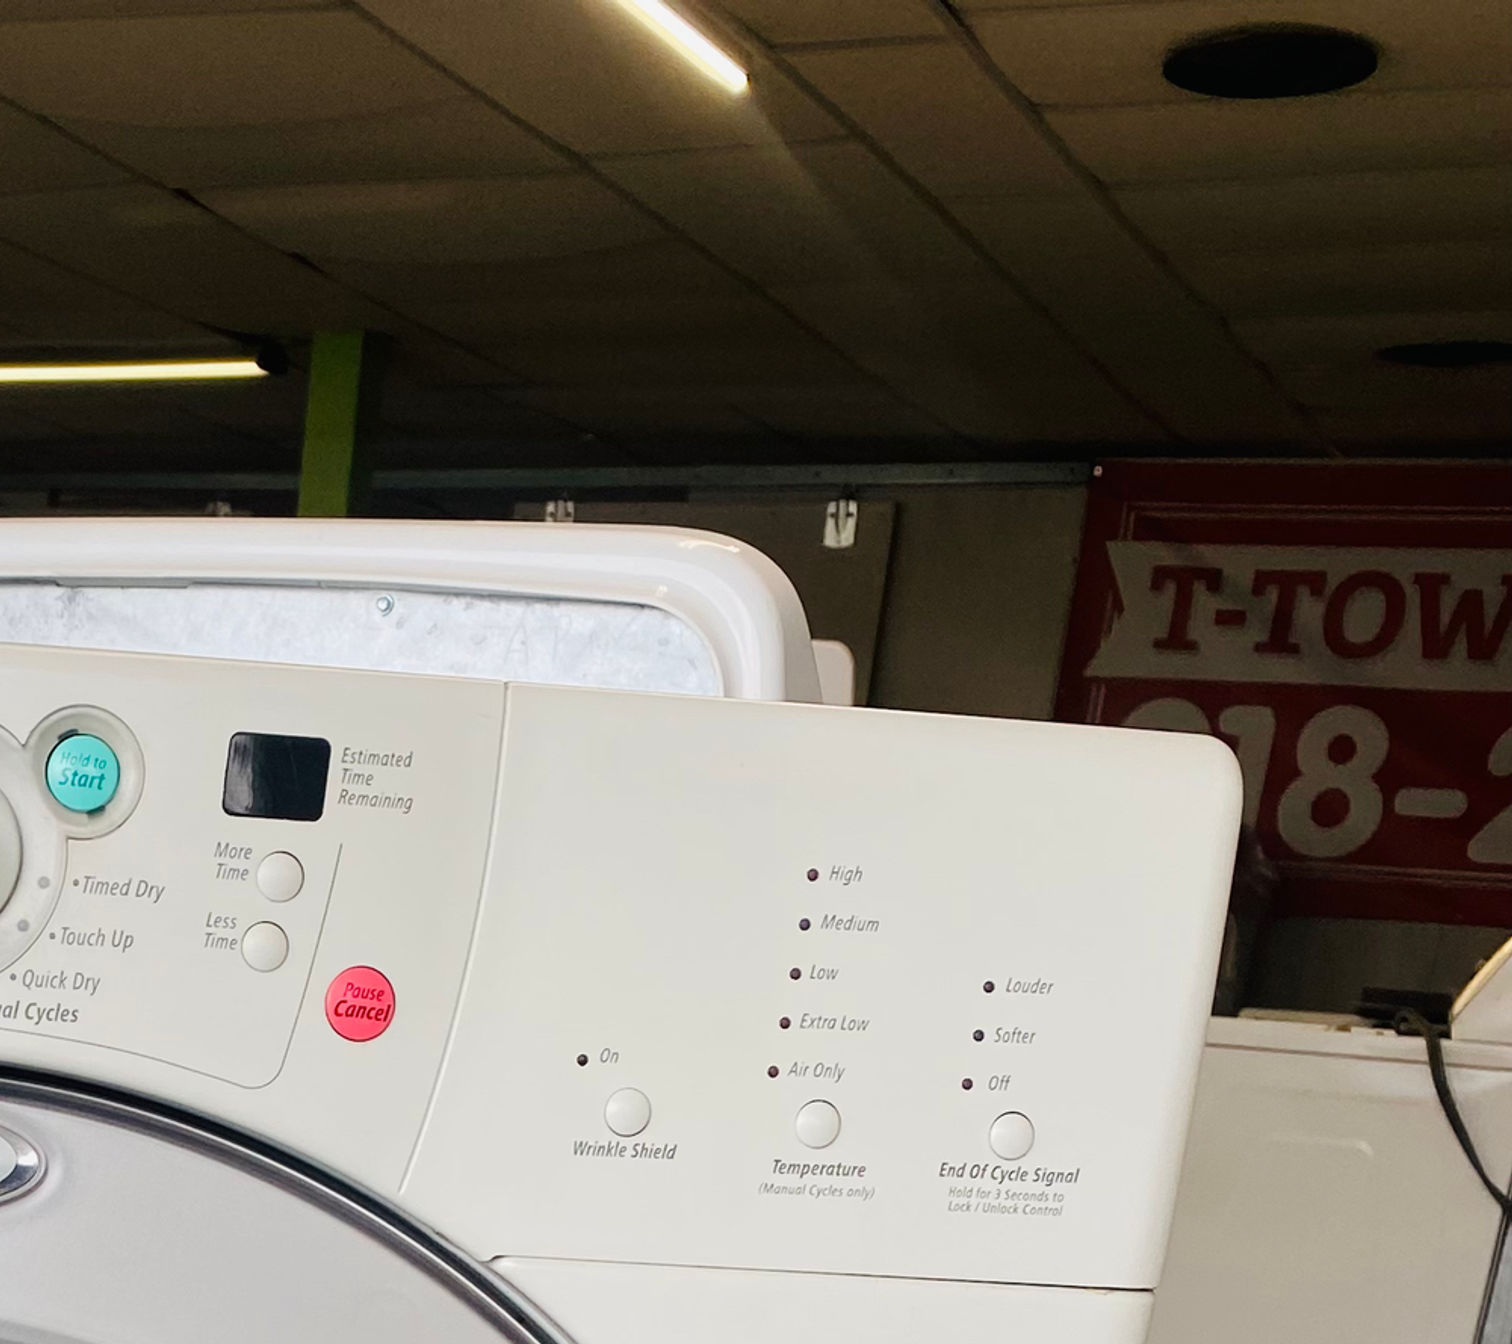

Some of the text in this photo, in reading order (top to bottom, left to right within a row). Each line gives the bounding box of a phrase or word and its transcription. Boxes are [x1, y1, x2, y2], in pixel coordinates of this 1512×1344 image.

[60, 751, 107, 770] Hold to
[341, 748, 413, 768] Estimated
[58, 768, 106, 791] Start
[340, 768, 374, 786] Time
[338, 789, 413, 814] Remaining
[214, 842, 252, 860] More
[216, 863, 249, 881] Time
[829, 866, 862, 885] High
[82, 876, 166, 903] Timed Dry
[206, 912, 237, 929] Less
[820, 914, 879, 932] Medium
[60, 927, 134, 952] Touch Up
[204, 932, 237, 951] Time
[810, 964, 838, 980] Low
[22, 969, 100, 996] Quick Dry
[344, 982, 384, 1002] Pause
[1006, 978, 1054, 995] Louder
[24, 1002, 79, 1025] Cycles
[334, 999, 390, 1022] Cancel
[800, 1013, 869, 1032] Extra Low
[994, 1027, 1036, 1044] Softer
[600, 1048, 619, 1064] On
[788, 1062, 845, 1083] Air Only
[988, 1075, 1011, 1091] Off
[573, 1140, 677, 1160] Wrinkle Shield
[772, 1159, 866, 1178] Temperature
[939, 1163, 1080, 1187] End Of Cycle Signal
[758, 1182, 875, 1200] (Manual Cycles only)
[948, 1186, 1064, 1202] Hold for 3 Seconds to
[948, 1200, 972, 1212] Lock
[982, 1201, 1018, 1214] Unlock
[1022, 1203, 1062, 1216] Control
